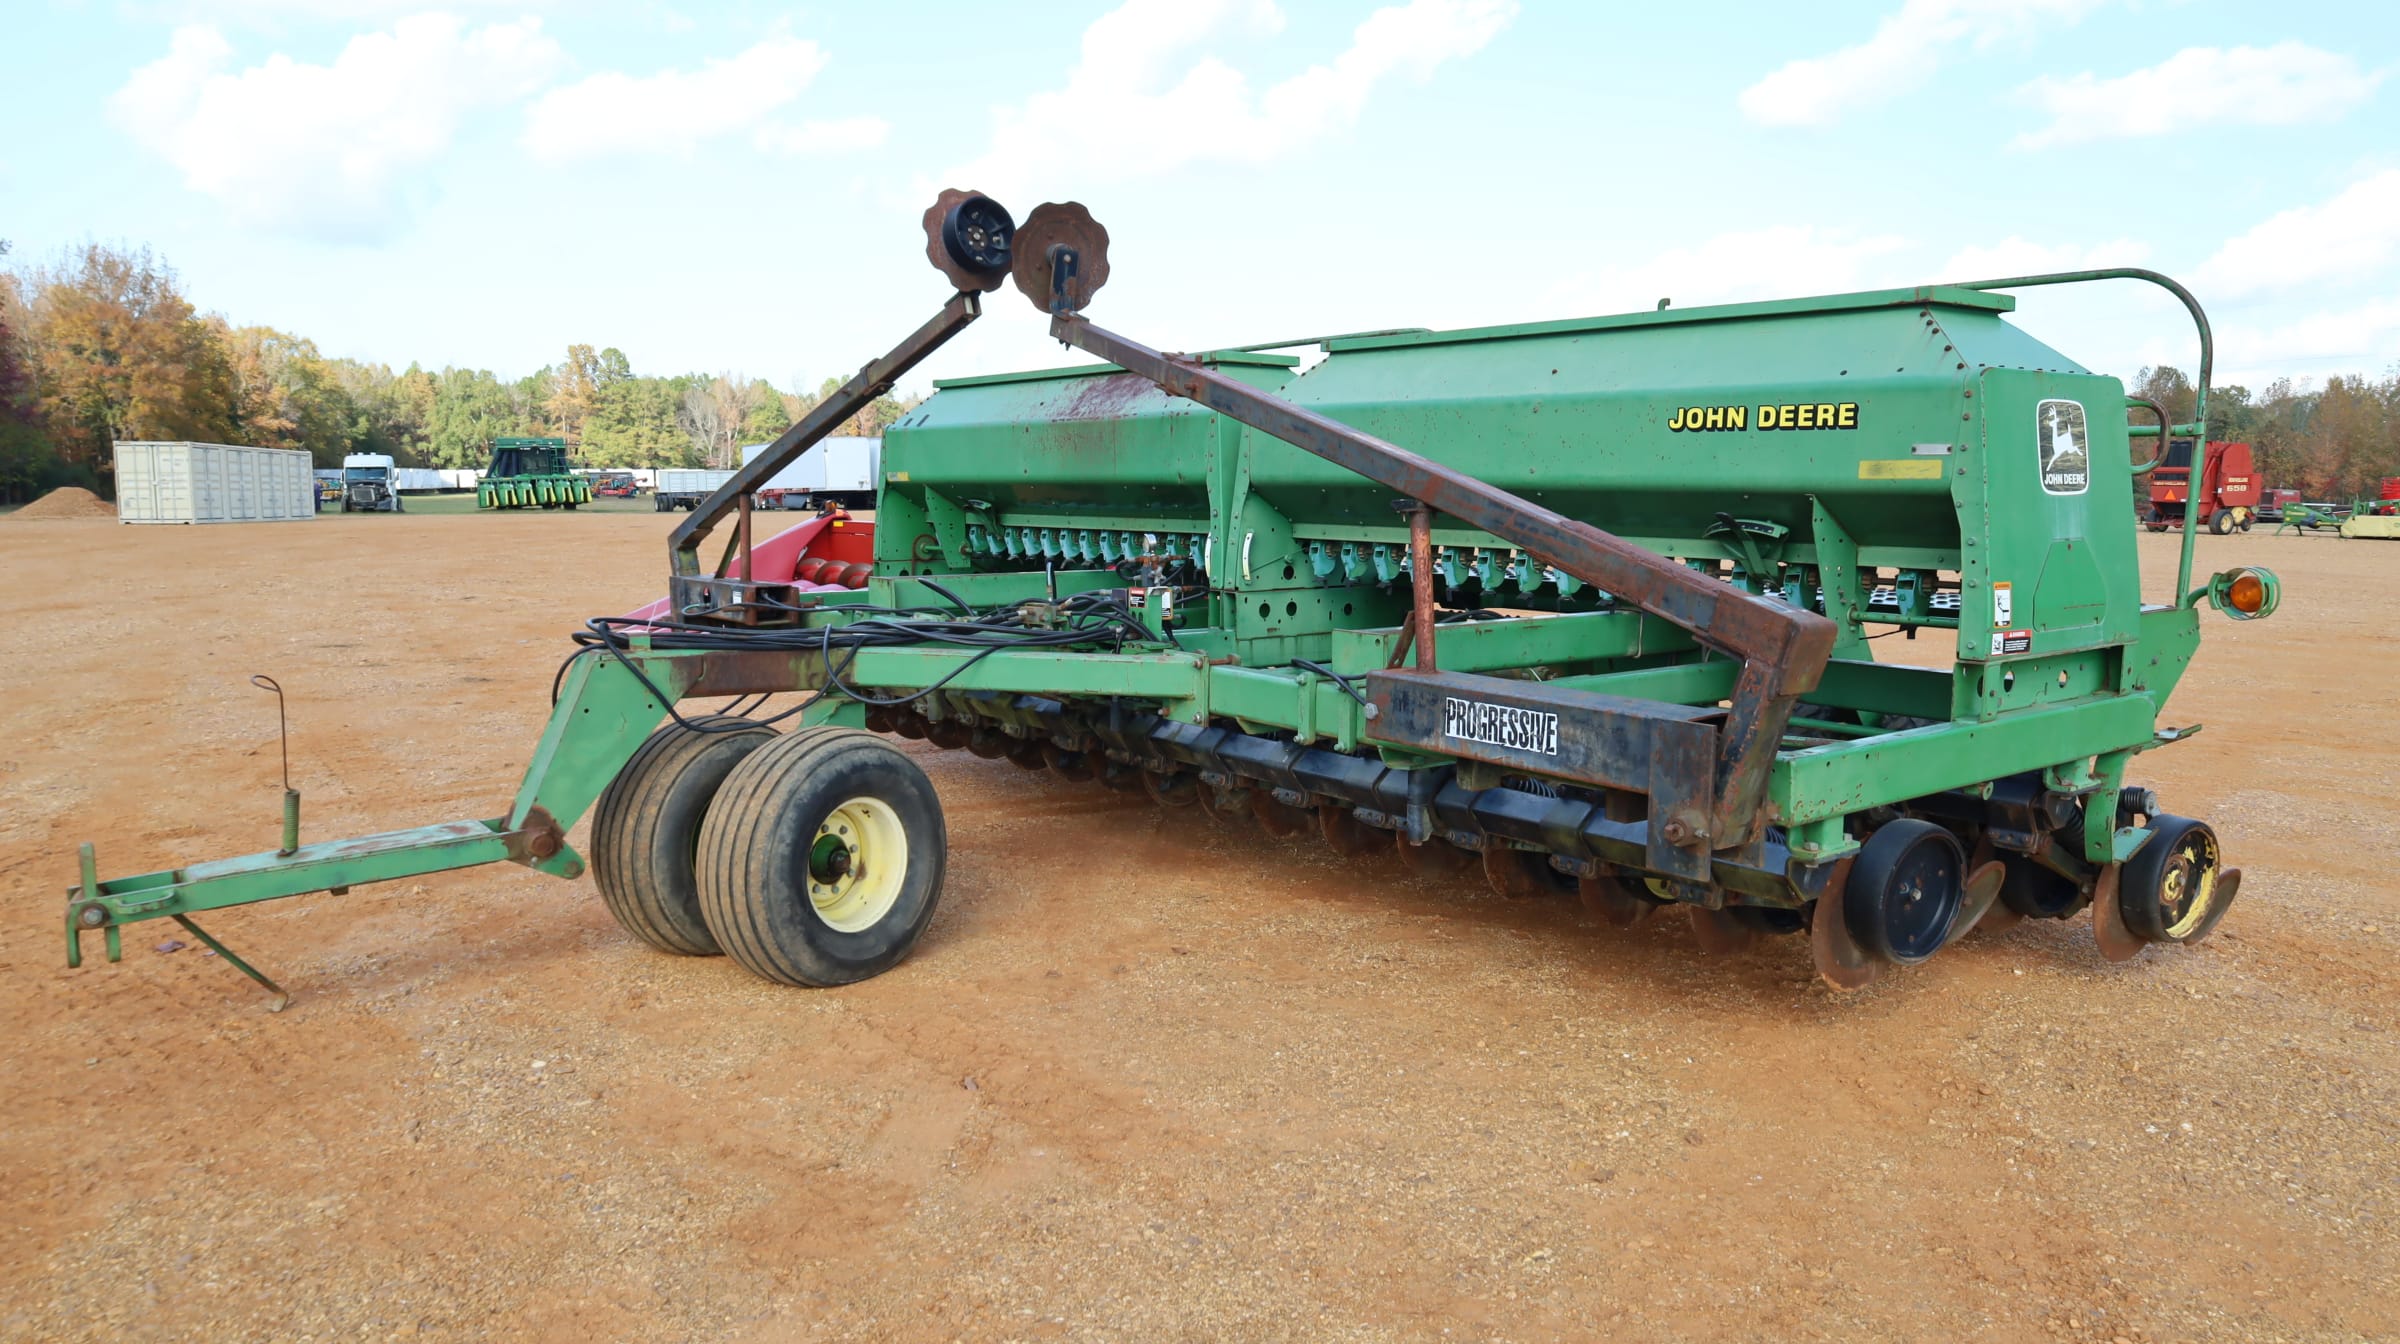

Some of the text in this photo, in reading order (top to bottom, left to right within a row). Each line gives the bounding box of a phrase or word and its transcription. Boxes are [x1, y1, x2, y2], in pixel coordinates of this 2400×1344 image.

[1668, 402, 1859, 432] JOHN DEERE
[2044, 473, 2085, 485] JOHN DEERE
[1445, 698, 1556, 753] PROGRESSIVE
